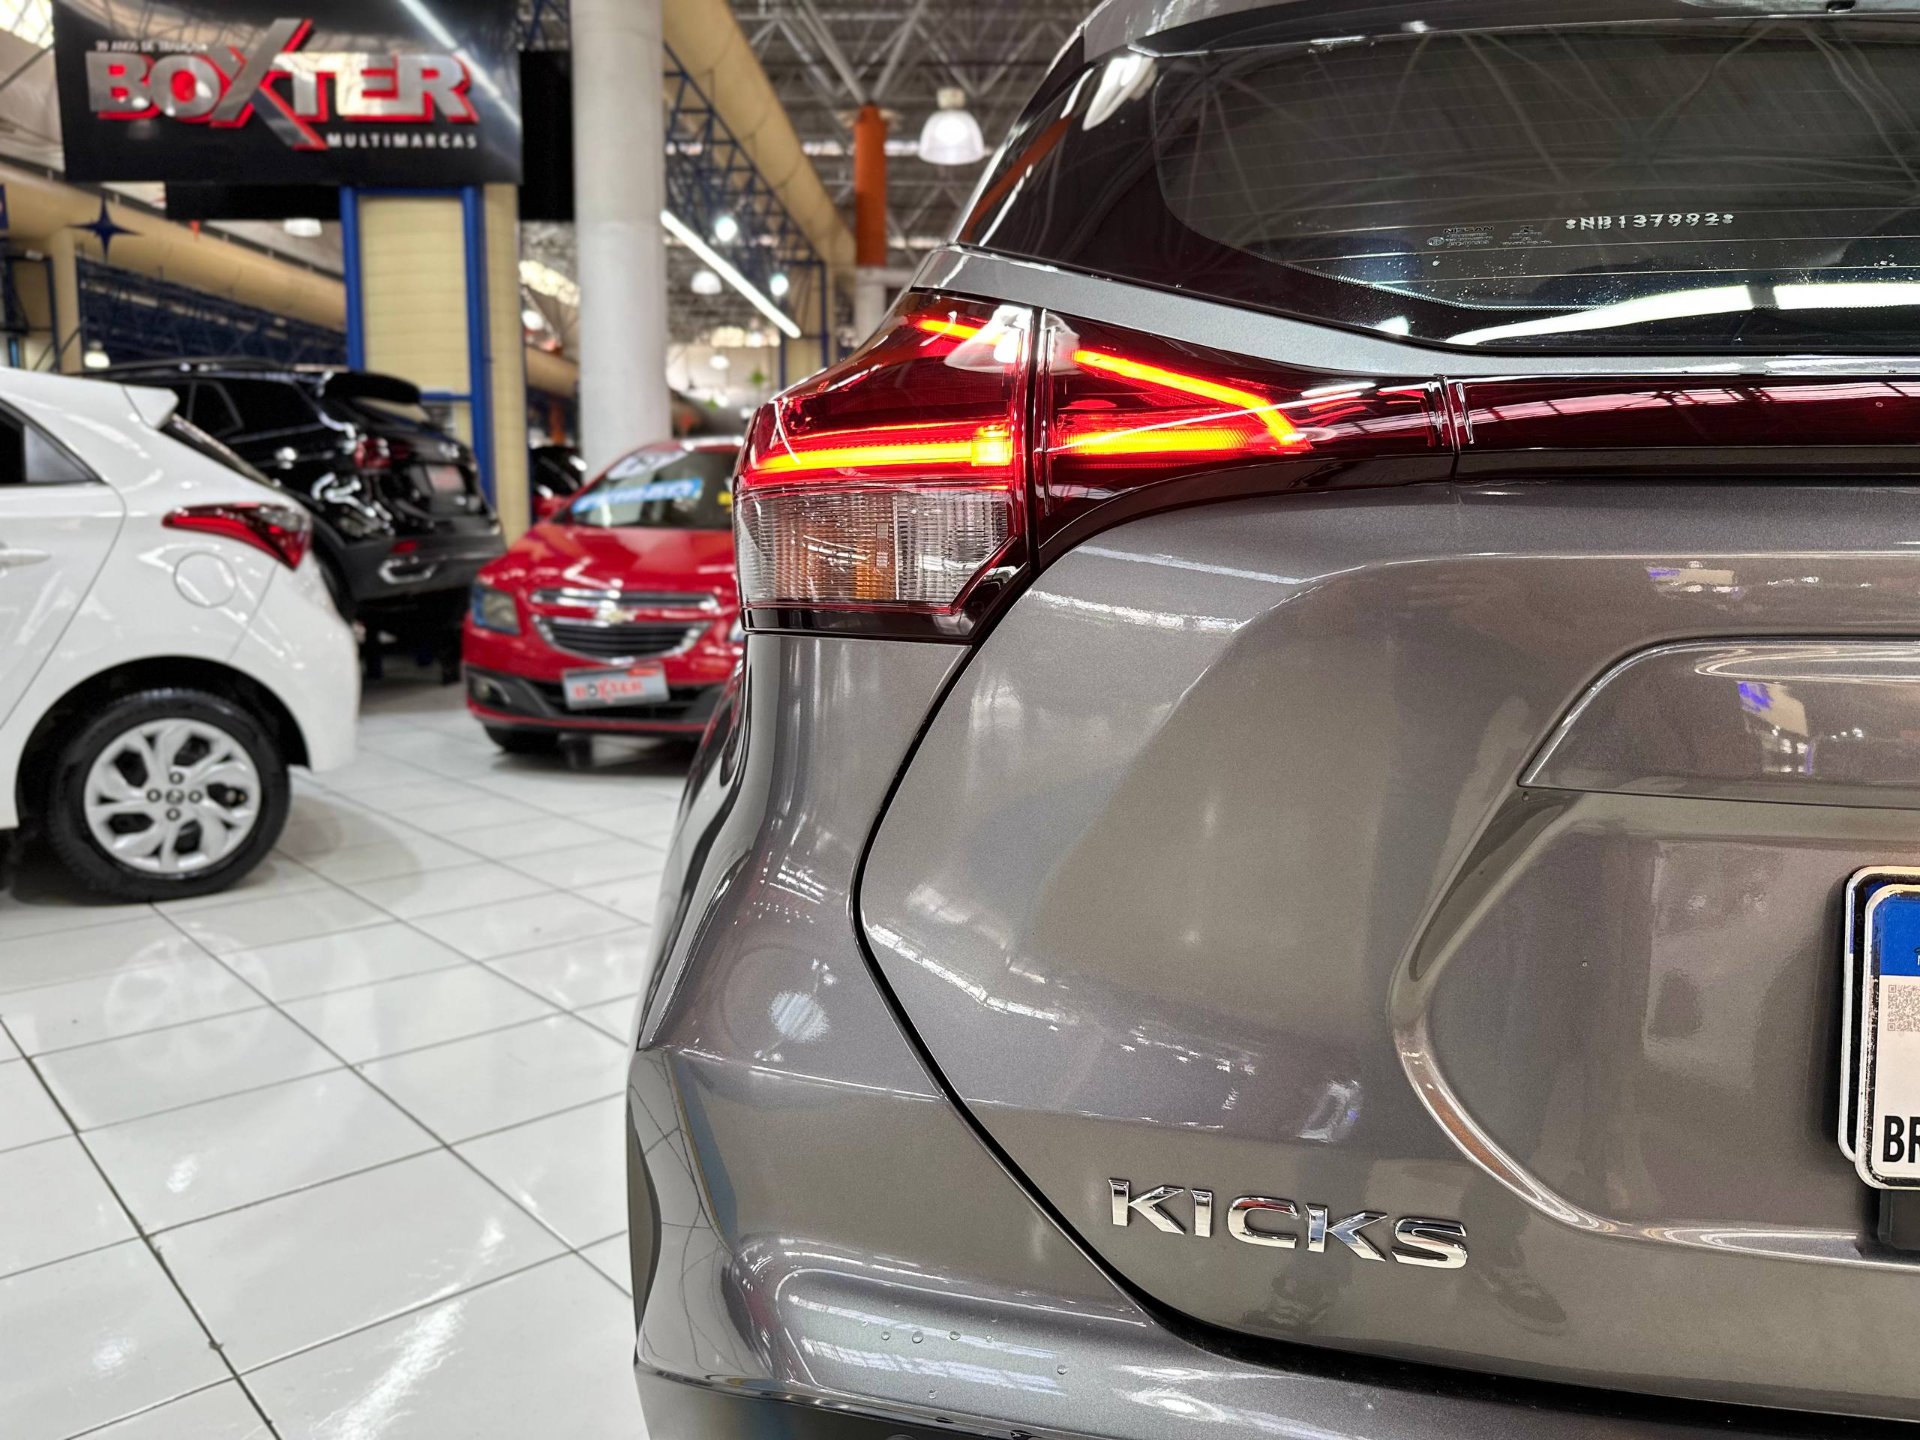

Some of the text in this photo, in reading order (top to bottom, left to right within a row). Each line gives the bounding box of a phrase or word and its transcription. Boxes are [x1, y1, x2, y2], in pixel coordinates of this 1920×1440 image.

[86, 18, 480, 150] BOXTER
[326, 133, 478, 149] MULTIMARCAS
[1108, 1177, 1469, 1270] KICKS
